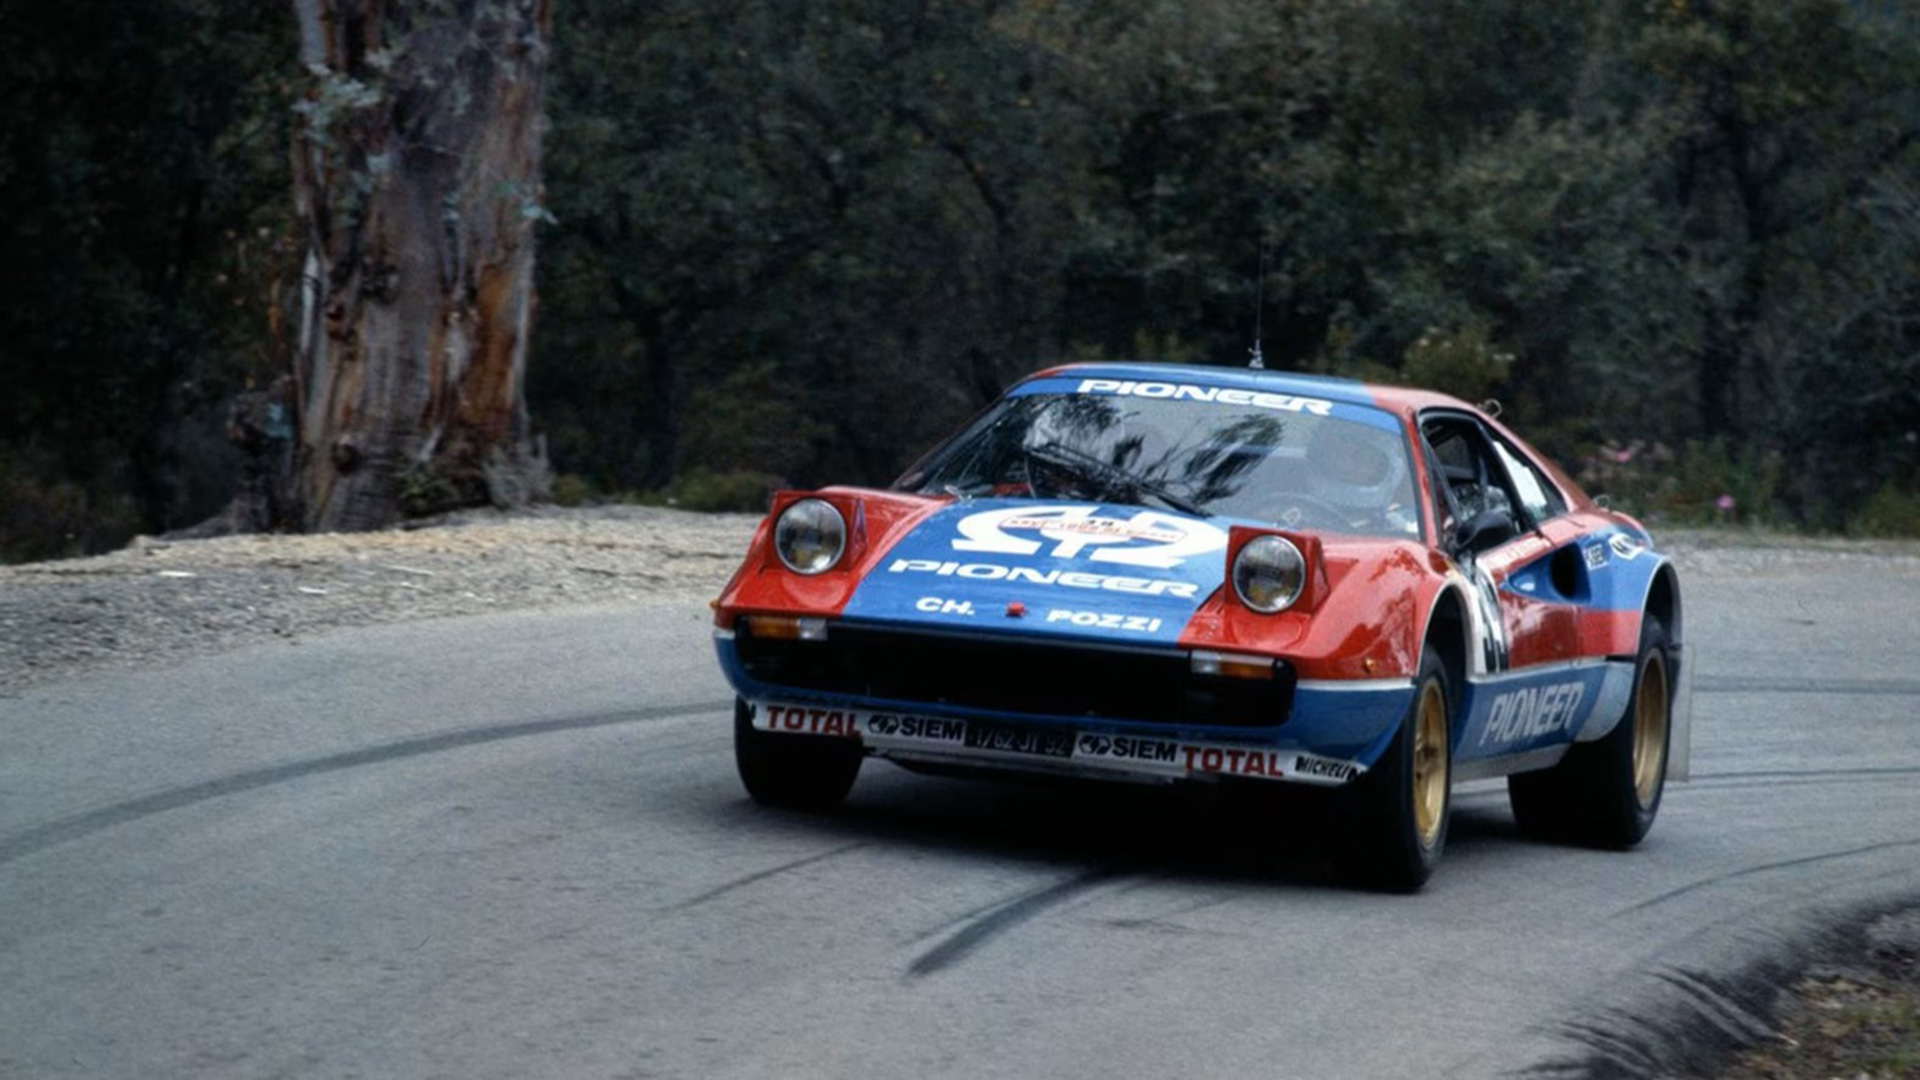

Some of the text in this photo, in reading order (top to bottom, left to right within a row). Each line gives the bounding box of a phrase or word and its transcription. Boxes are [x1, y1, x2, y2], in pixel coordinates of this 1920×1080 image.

[1077, 379, 1333, 417] PIONEER
[888, 559, 1199, 599] PIONEER
[915, 597, 1162, 633] CH. POZZI
[766, 705, 862, 738] TOTAL
[900, 715, 965, 742] SIEM
[1478, 681, 1585, 747] PIONEER
[1113, 736, 1179, 763] SIEM
[1182, 745, 1284, 777] TOTAL
